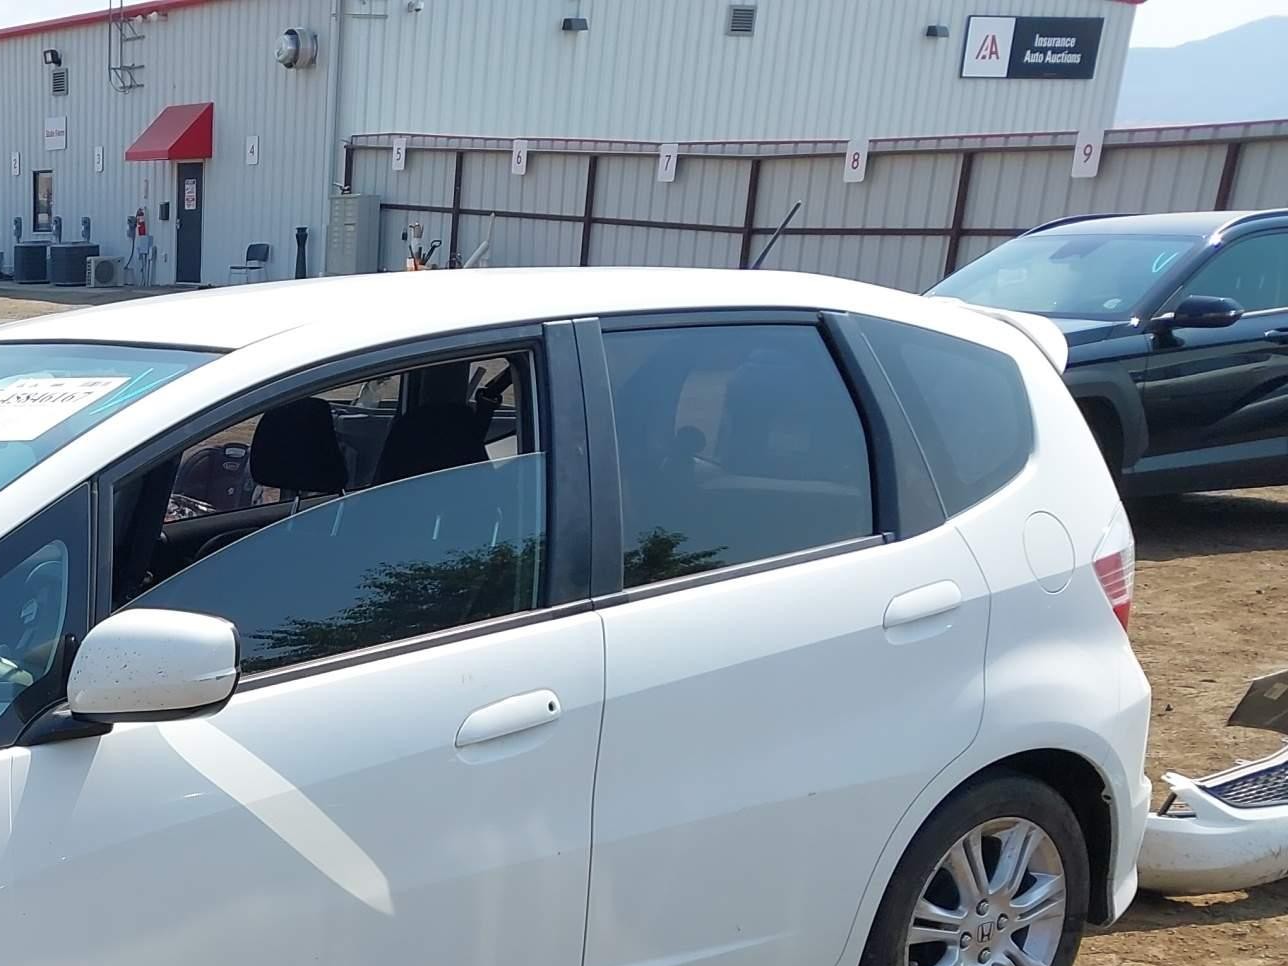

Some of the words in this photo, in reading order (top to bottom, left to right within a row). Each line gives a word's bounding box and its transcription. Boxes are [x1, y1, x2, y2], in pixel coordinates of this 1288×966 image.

[1034, 33, 1077, 48] Insurance
[1024, 49, 1044, 63] Auto
[1046, 50, 1082, 64] Auctions
[249, 144, 255, 156] 4
[395, 147, 402, 161] 5
[516, 150, 522, 164] 6
[1083, 144, 1093, 163] 9
[665, 154, 672, 171] 7
[851, 152, 861, 170] 8
